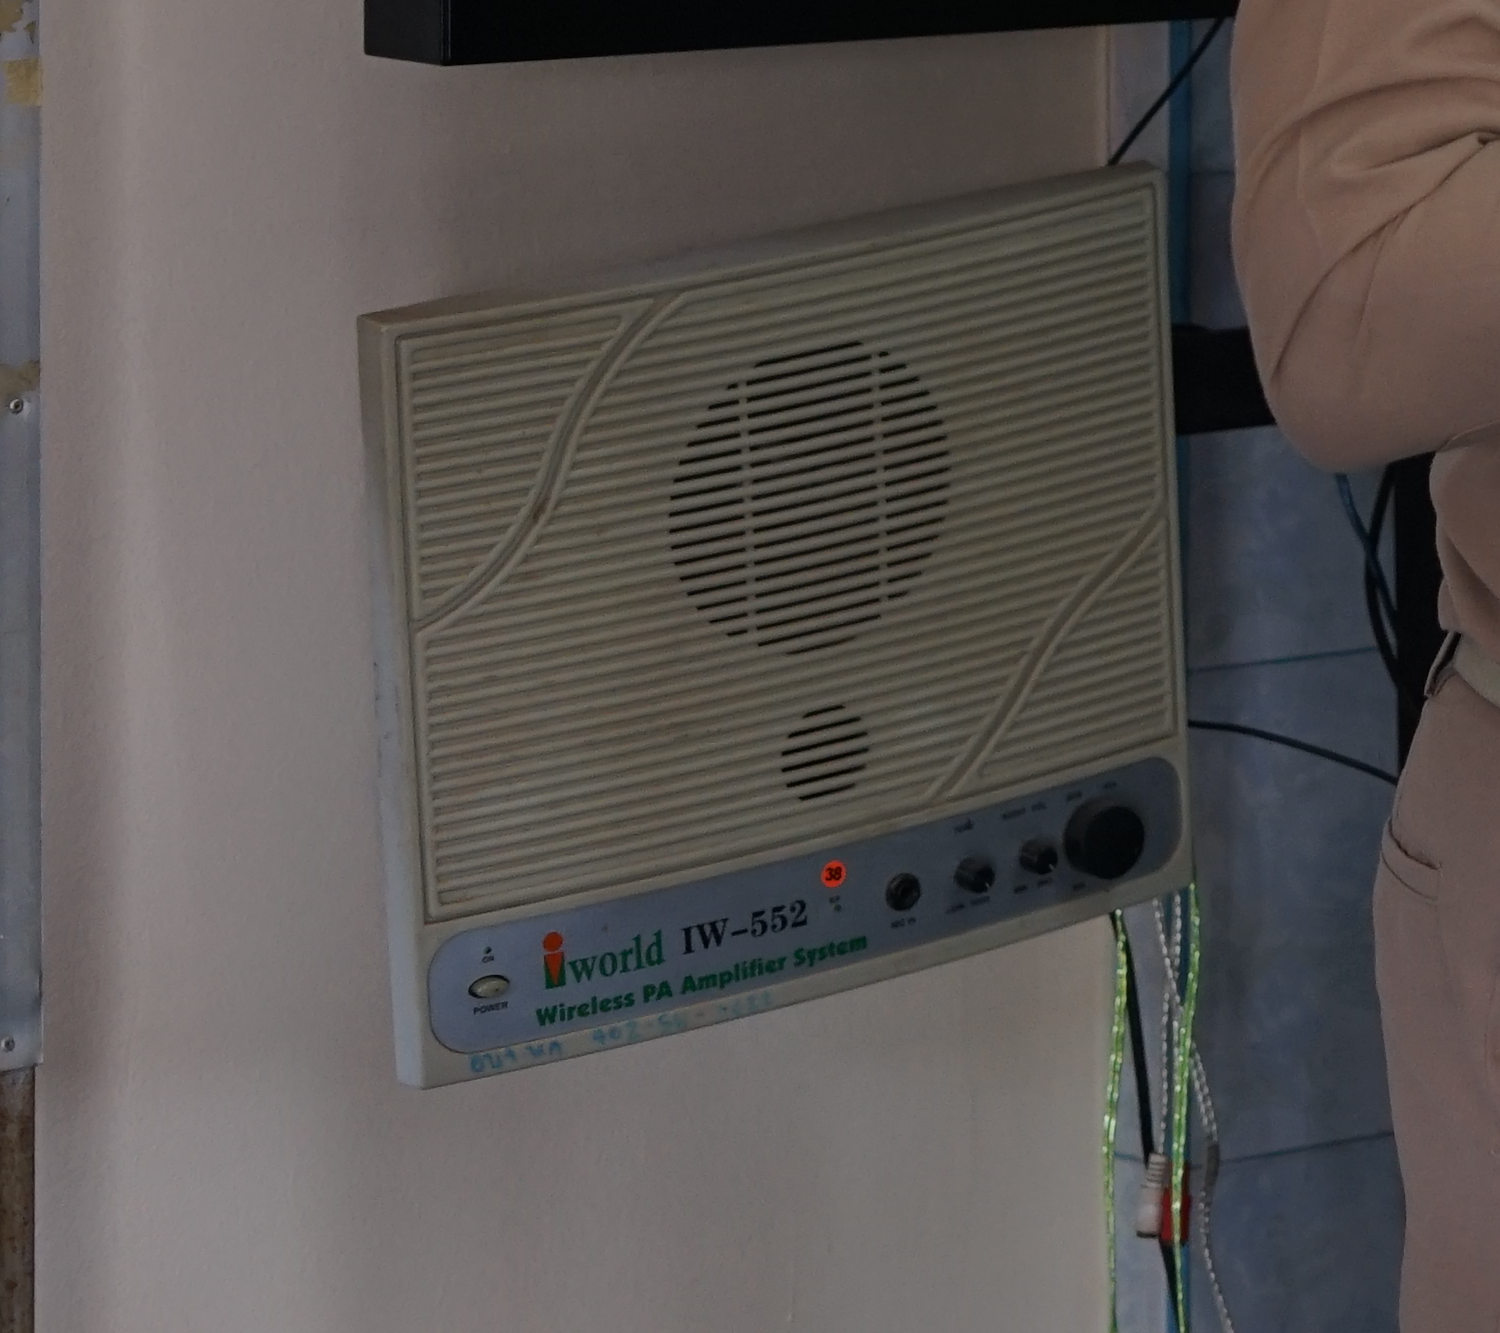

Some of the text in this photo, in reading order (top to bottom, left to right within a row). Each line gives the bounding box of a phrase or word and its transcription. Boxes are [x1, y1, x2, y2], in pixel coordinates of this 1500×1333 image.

[824, 864, 843, 883] 38
[680, 899, 810, 957] IW-552
[535, 934, 869, 1027] Wireless PA Amplifier System
